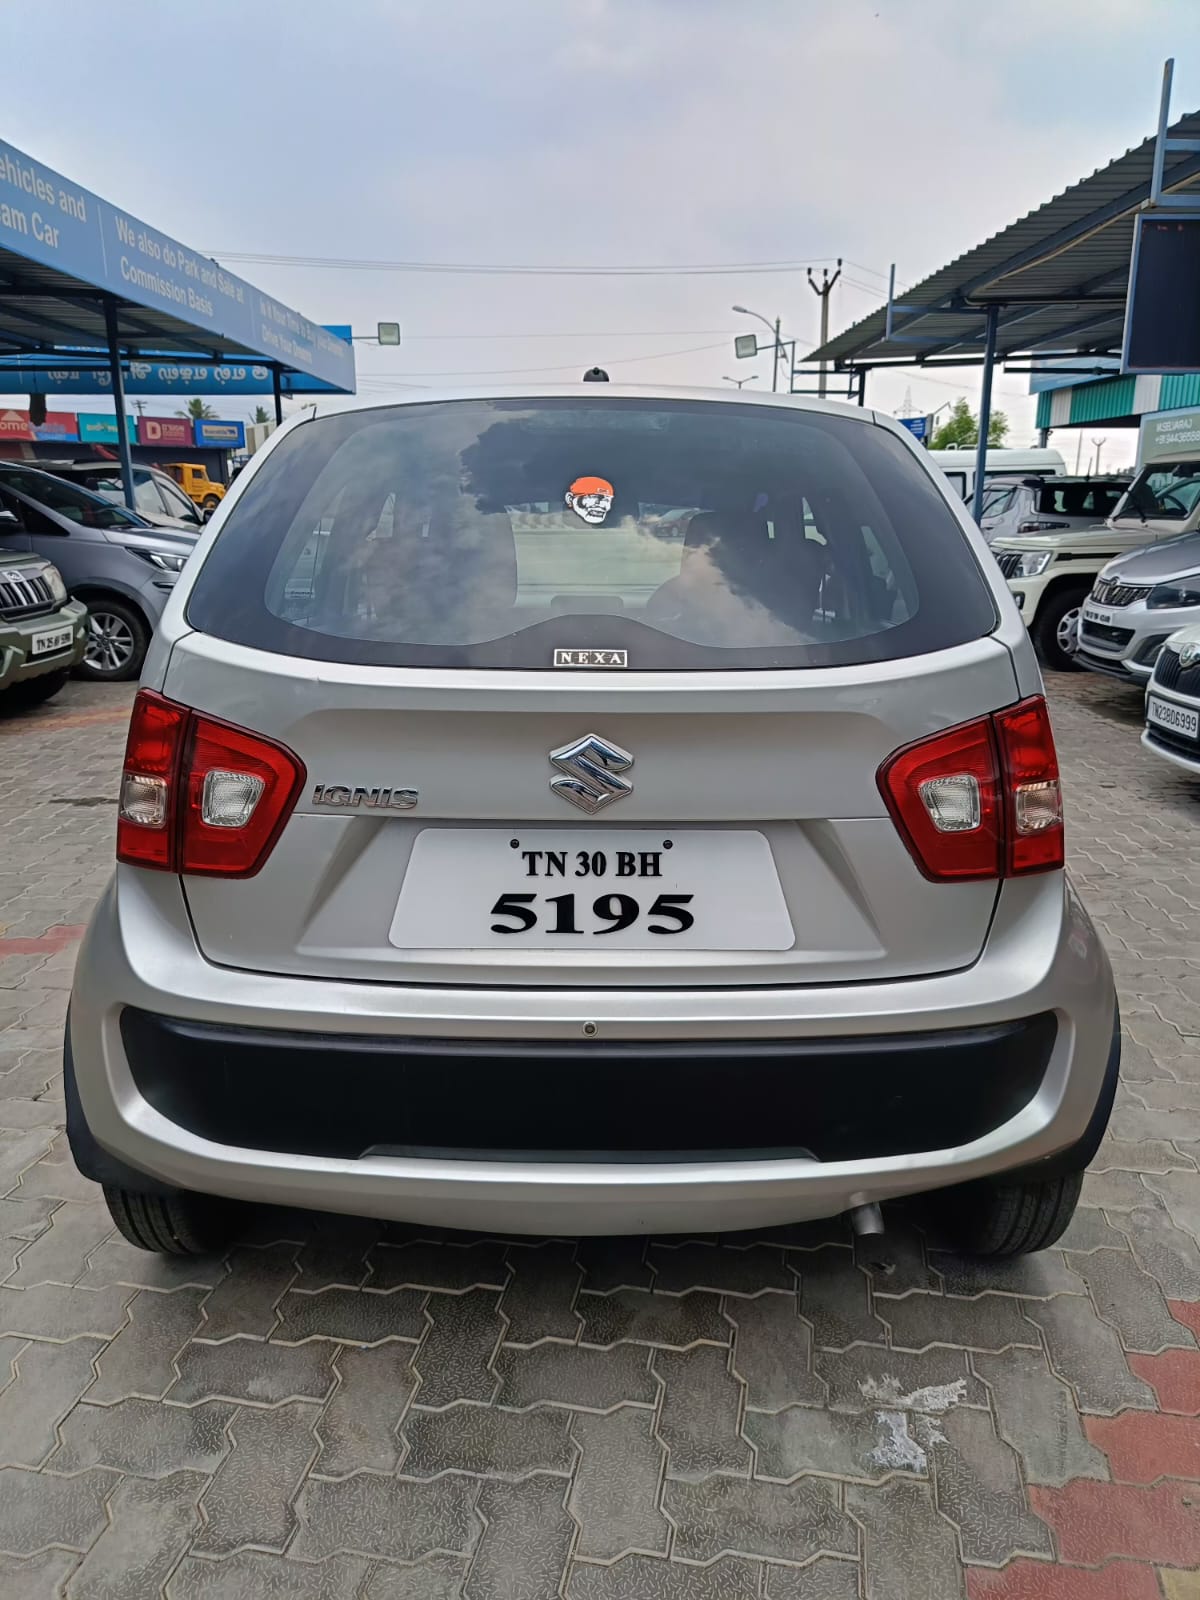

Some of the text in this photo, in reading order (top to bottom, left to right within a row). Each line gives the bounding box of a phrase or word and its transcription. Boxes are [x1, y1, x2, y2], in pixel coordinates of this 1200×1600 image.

[59, 190, 87, 223] and
[31, 211, 59, 249] Car
[115, 215, 136, 247] We
[138, 232, 161, 260] also
[163, 244, 177, 268] do
[178, 250, 200, 280] Park
[200, 265, 217, 289] and
[120, 255, 187, 305] Commission
[187, 287, 214, 317] Basis
[559, 651, 623, 665] NEXA
[312, 784, 418, 809] IGNIS
[522, 850, 663, 877] TN 30 BH
[490, 893, 695, 935] 5195
